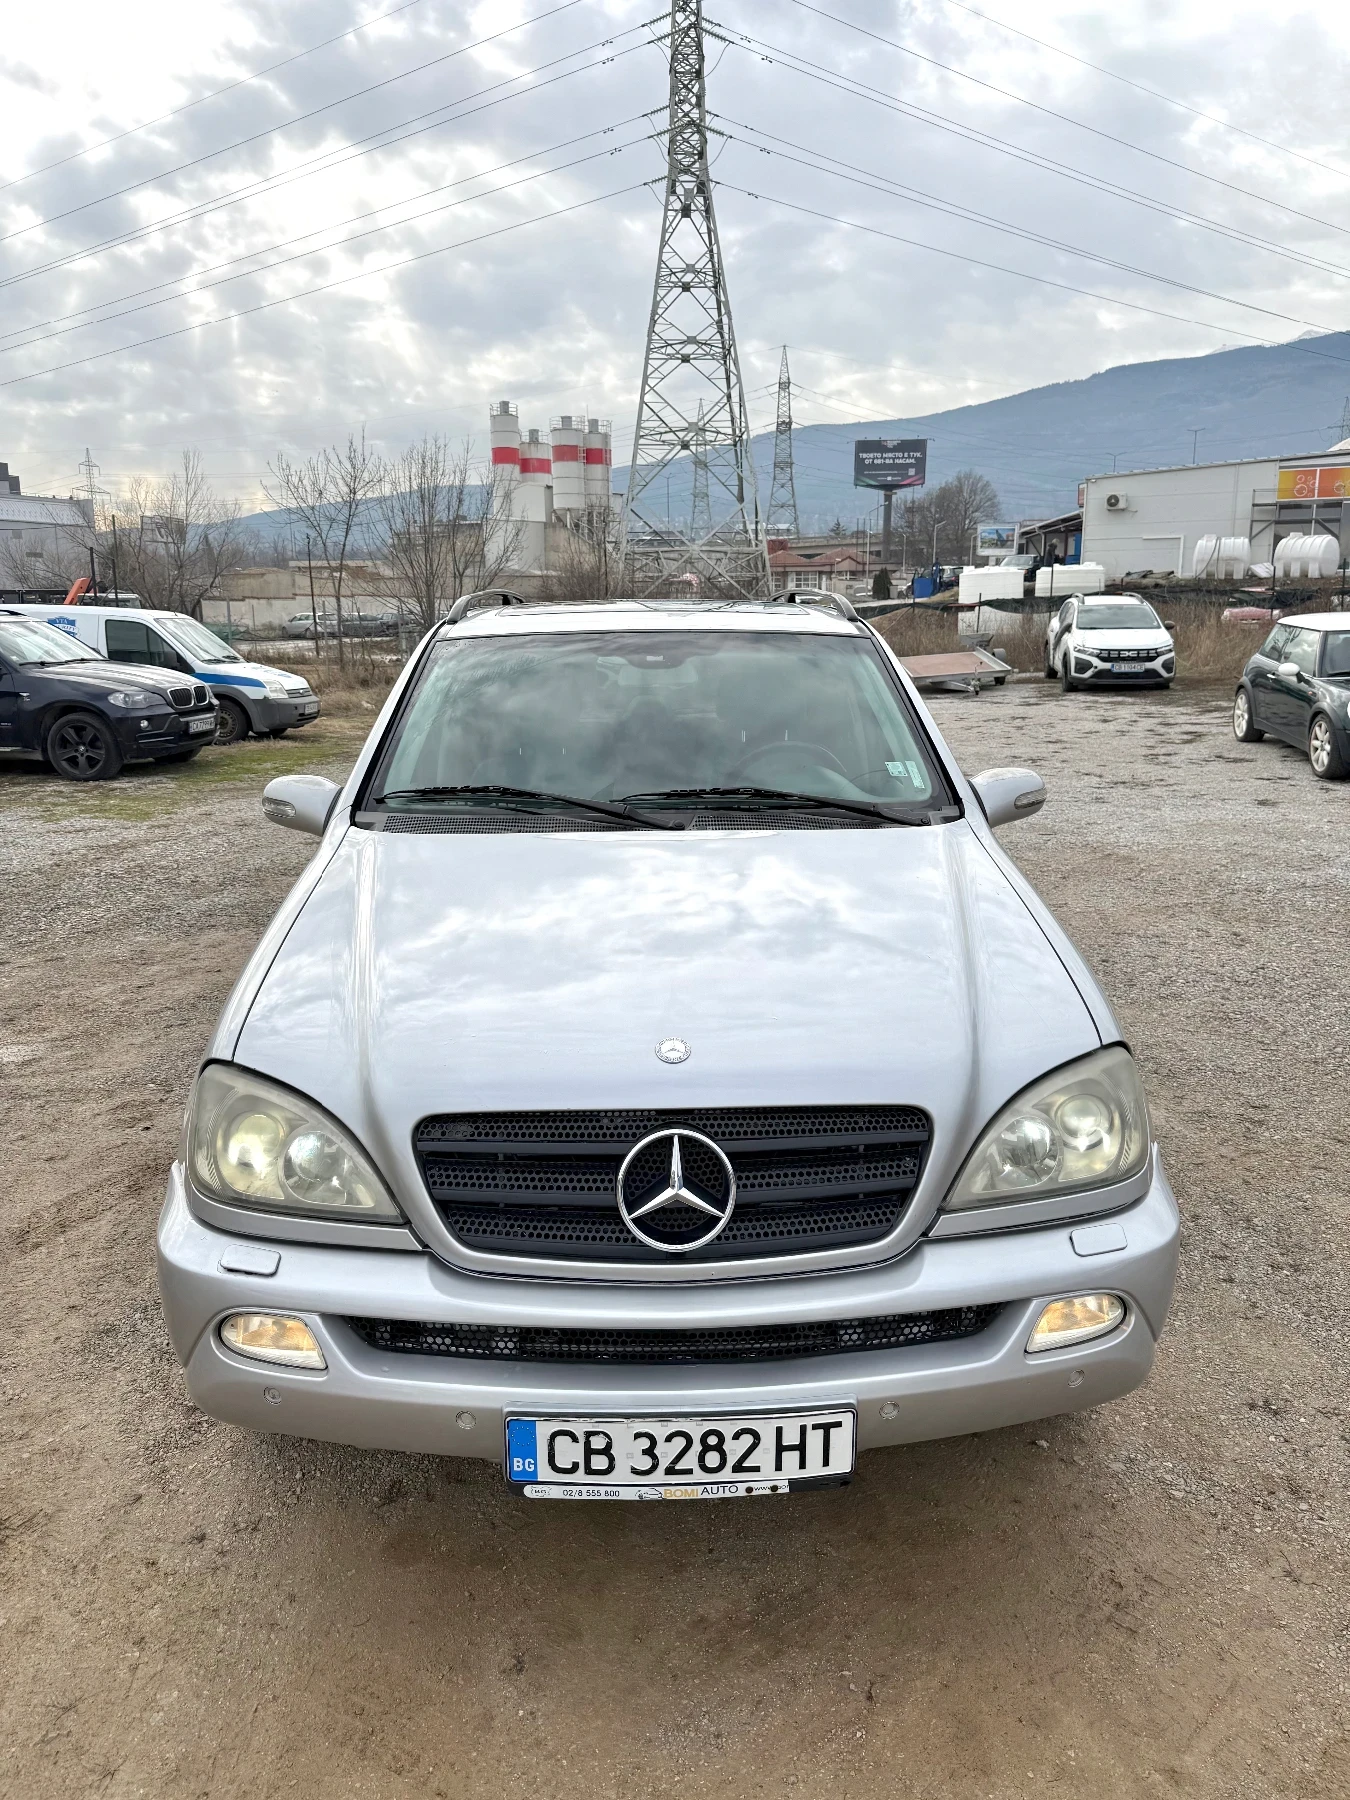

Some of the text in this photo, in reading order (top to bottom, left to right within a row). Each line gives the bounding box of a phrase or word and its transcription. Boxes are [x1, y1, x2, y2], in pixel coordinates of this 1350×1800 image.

[547, 1420, 843, 1476] CB 3282 HT
[513, 1457, 535, 1472] BG
[562, 1489, 620, 1498] 02/8 555 800
[663, 1484, 739, 1499] BOMI AUTO
